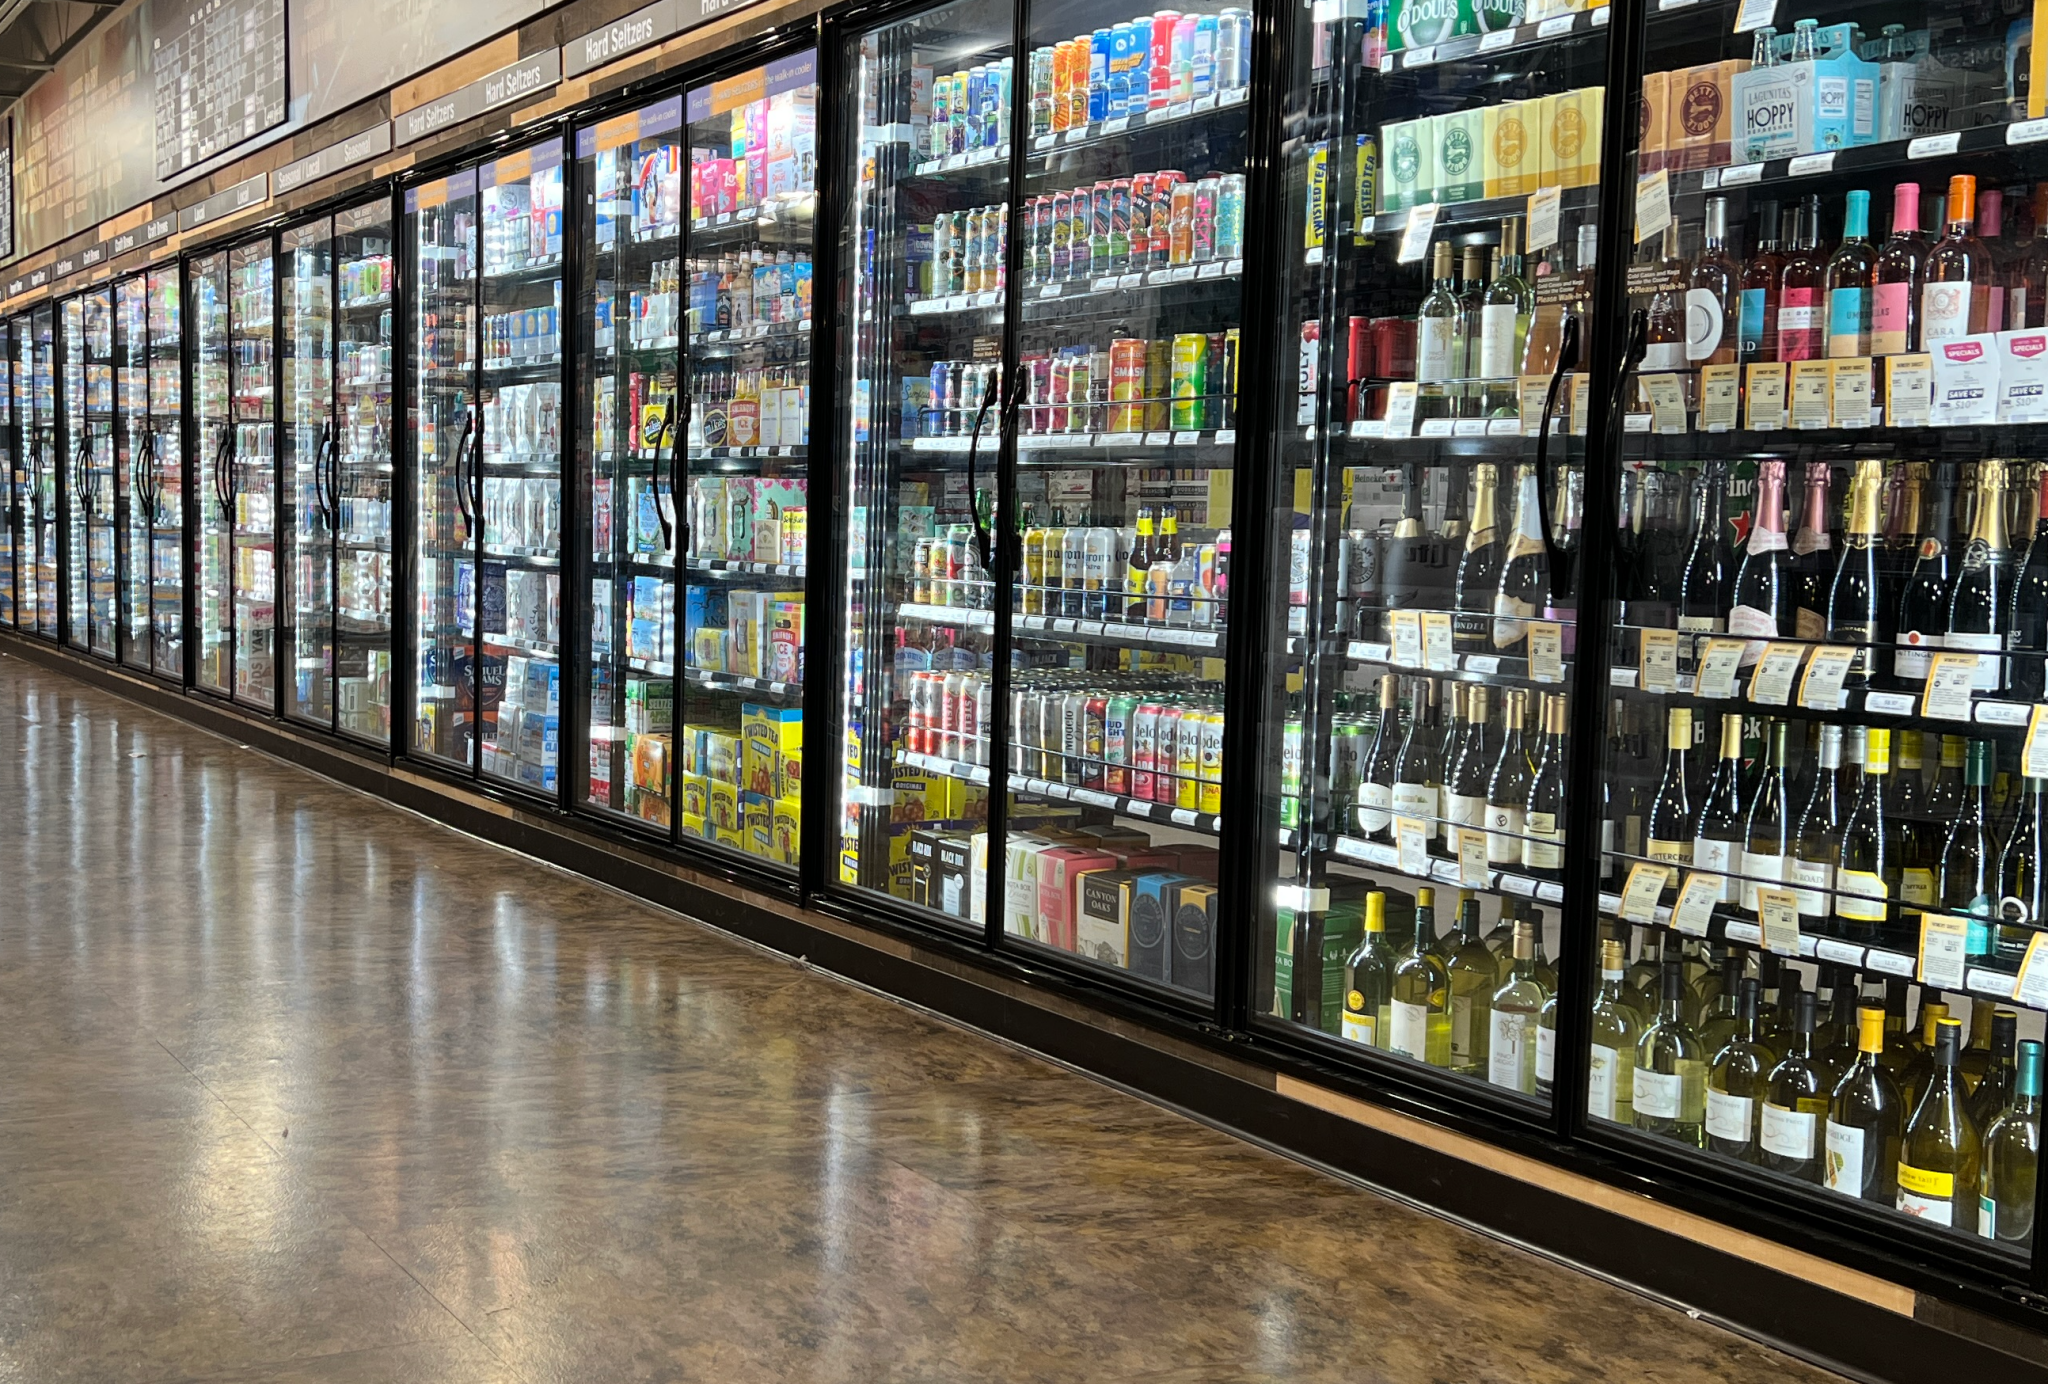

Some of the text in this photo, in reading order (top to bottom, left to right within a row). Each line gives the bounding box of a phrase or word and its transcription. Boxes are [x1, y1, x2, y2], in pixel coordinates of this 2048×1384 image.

[1398, 1, 1459, 32] O'DOUL'S
[585, 17, 653, 63] Hard Seltzers
[485, 64, 541, 104] Hard Seltzers
[692, 98, 702, 109] Find
[766, 74, 774, 86] the
[774, 68, 794, 83] walk-in
[795, 62, 812, 76] cooler
[1686, 86, 1715, 102] BETTY
[1748, 87, 1791, 106] LAGUNITAS
[1821, 92, 1845, 104] HOPPY
[408, 101, 455, 136] Hard Seltzers
[647, 113, 662, 125] walk-in
[662, 108, 677, 120] cooler
[1686, 114, 1715, 131] BOOZE
[1747, 103, 1794, 129] HOPPY
[1904, 104, 1949, 129] HOPPY
[1500, 122, 1522, 136] BETTY
[1446, 131, 1468, 144] BETTY
[344, 135, 371, 162] Seasonal
[1446, 158, 1468, 172] BOOZE
[278, 168, 302, 189] Seasonal
[306, 157, 320, 177] Local
[1361, 156, 1375, 216] ISTED TEA
[236, 186, 249, 205] Local
[1313, 163, 1326, 239] TWISTED TEA
[194, 205, 205, 222] Local
[1635, 283, 1686, 294] Please Walk-In
[1559, 293, 1582, 301] Walk-In
[1927, 328, 1954, 336] CARA
[1948, 348, 1980, 357] SPECIALS
[2013, 343, 2044, 352] SPECIALS
[1114, 366, 1145, 377] SMASH
[1949, 391, 1968, 399] SAVE
[2010, 387, 2028, 395] SAVE
[737, 419, 749, 428] ICE
[1354, 474, 1386, 483] Heineken
[776, 643, 788, 655] ICE
[464, 665, 505, 677] SUEL
[468, 676, 502, 686] AAMS
[744, 723, 778, 747] TWISTED TEA
[697, 784, 706, 796] TEA
[895, 782, 922, 790] ORIGINAL
[725, 794, 733, 806] TEA
[774, 815, 797, 830] TWISTED TEA
[912, 841, 932, 857] BLACK BOX
[941, 850, 964, 867] BLACK BOX
[1086, 888, 1117, 904] CANYON
[1091, 900, 1111, 914] OAKS
